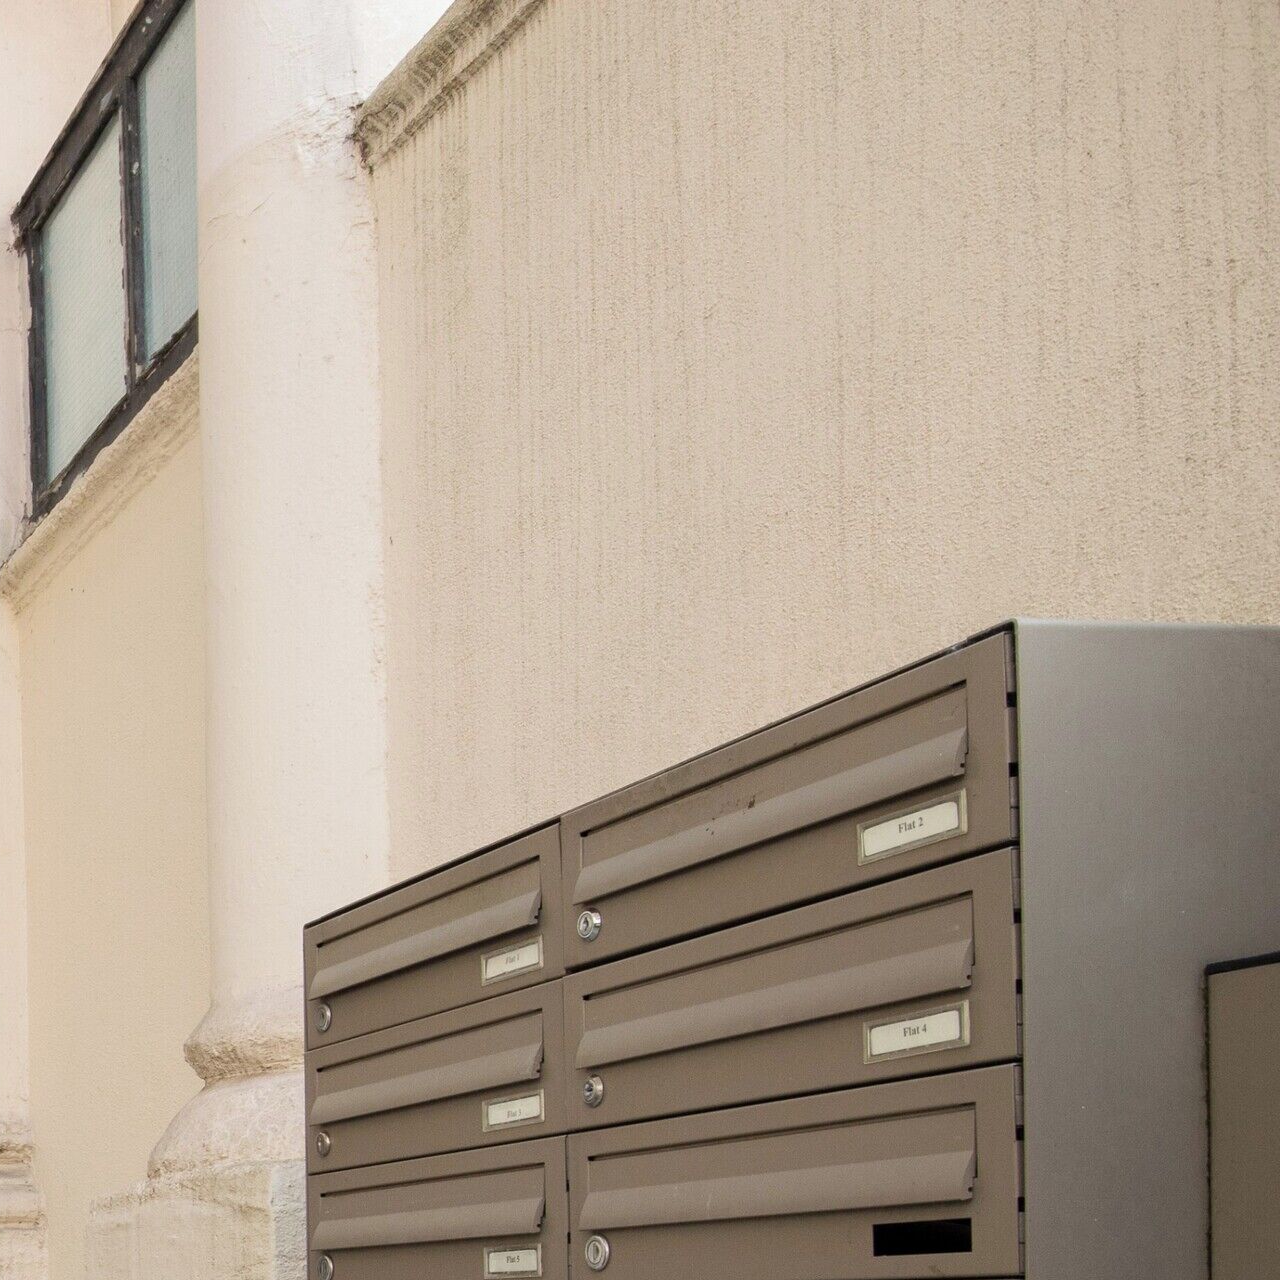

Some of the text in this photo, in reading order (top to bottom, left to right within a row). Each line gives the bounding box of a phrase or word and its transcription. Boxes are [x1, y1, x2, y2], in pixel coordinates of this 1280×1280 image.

[898, 817, 924, 833] Flat 2
[903, 1024, 927, 1037] Flat 4
